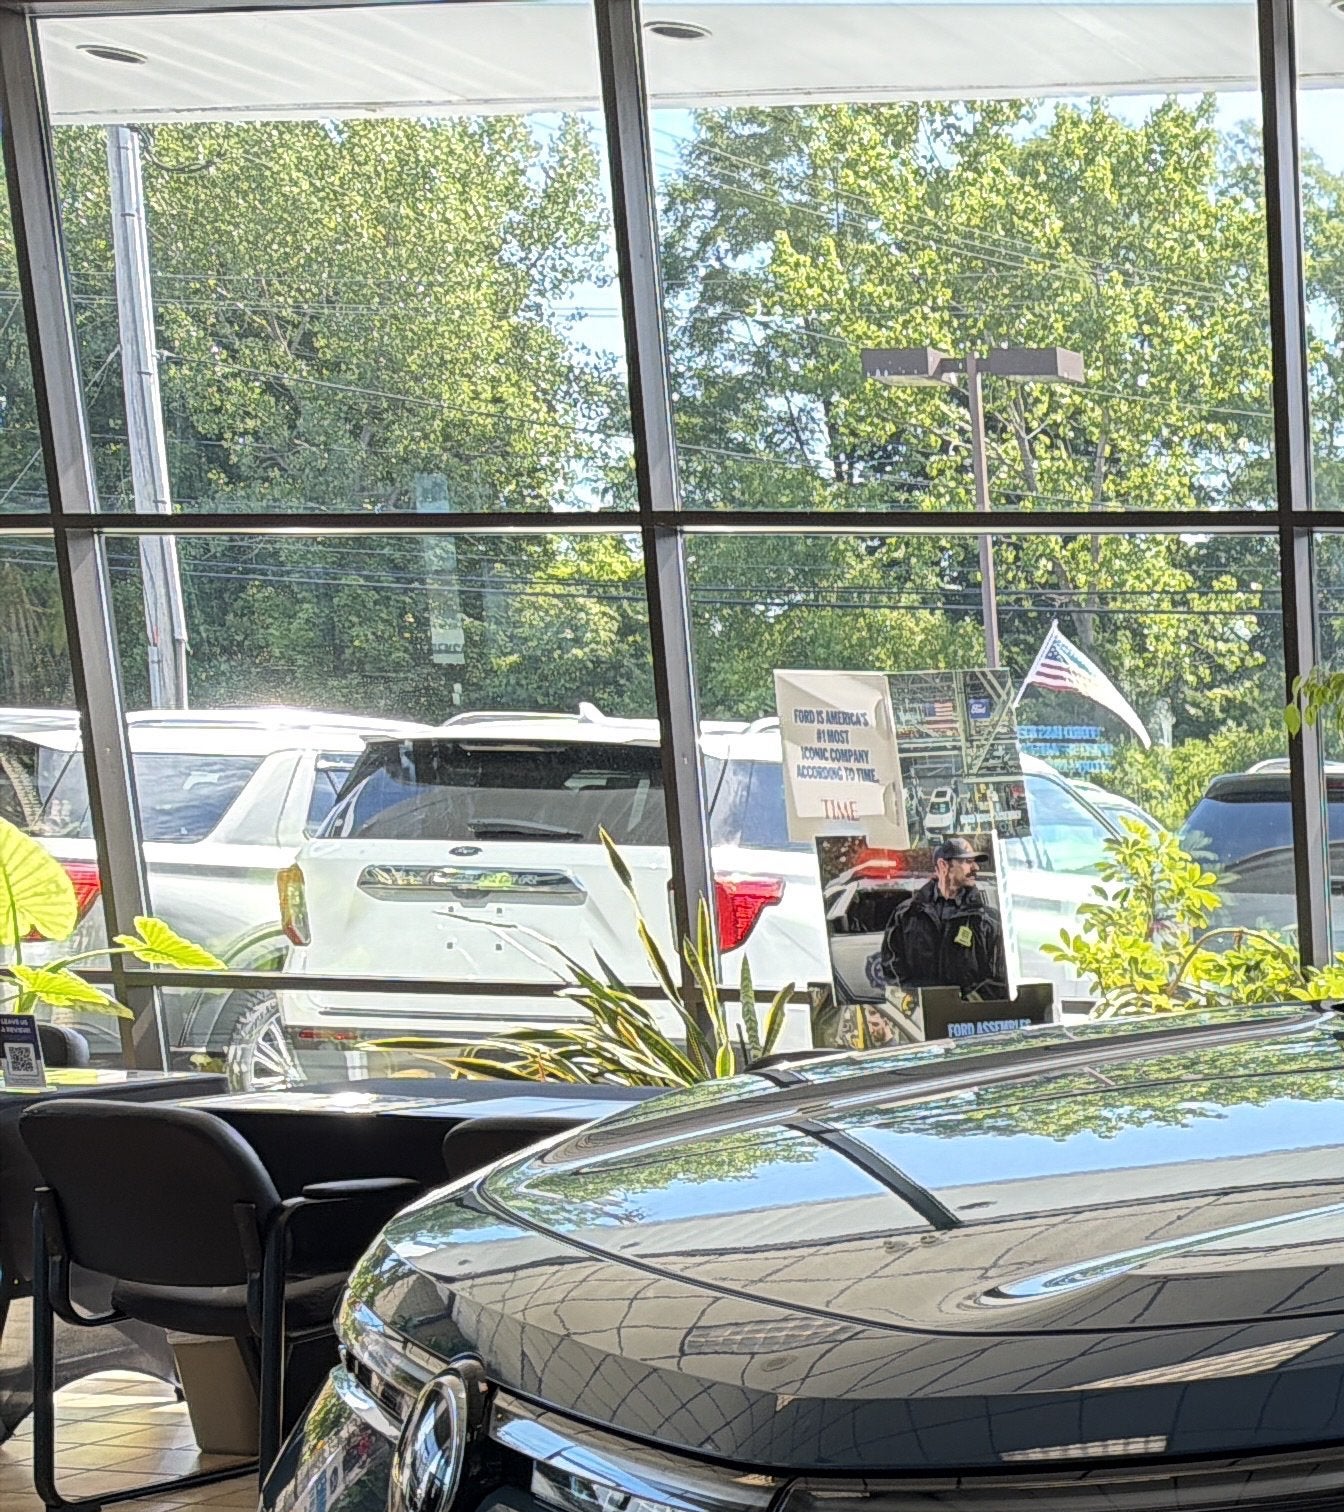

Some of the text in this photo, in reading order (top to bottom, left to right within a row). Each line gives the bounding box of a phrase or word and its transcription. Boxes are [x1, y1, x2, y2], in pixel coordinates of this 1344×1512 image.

[794, 709, 869, 727] FORD IS AMERICA'S
[816, 729, 849, 744] #1 MOST
[800, 746, 869, 764] ICONIC COMPANY
[796, 765, 880, 783] ACCORDING TO TIME.
[821, 799, 860, 821] TIME
[947, 1022, 975, 1038] FORD
